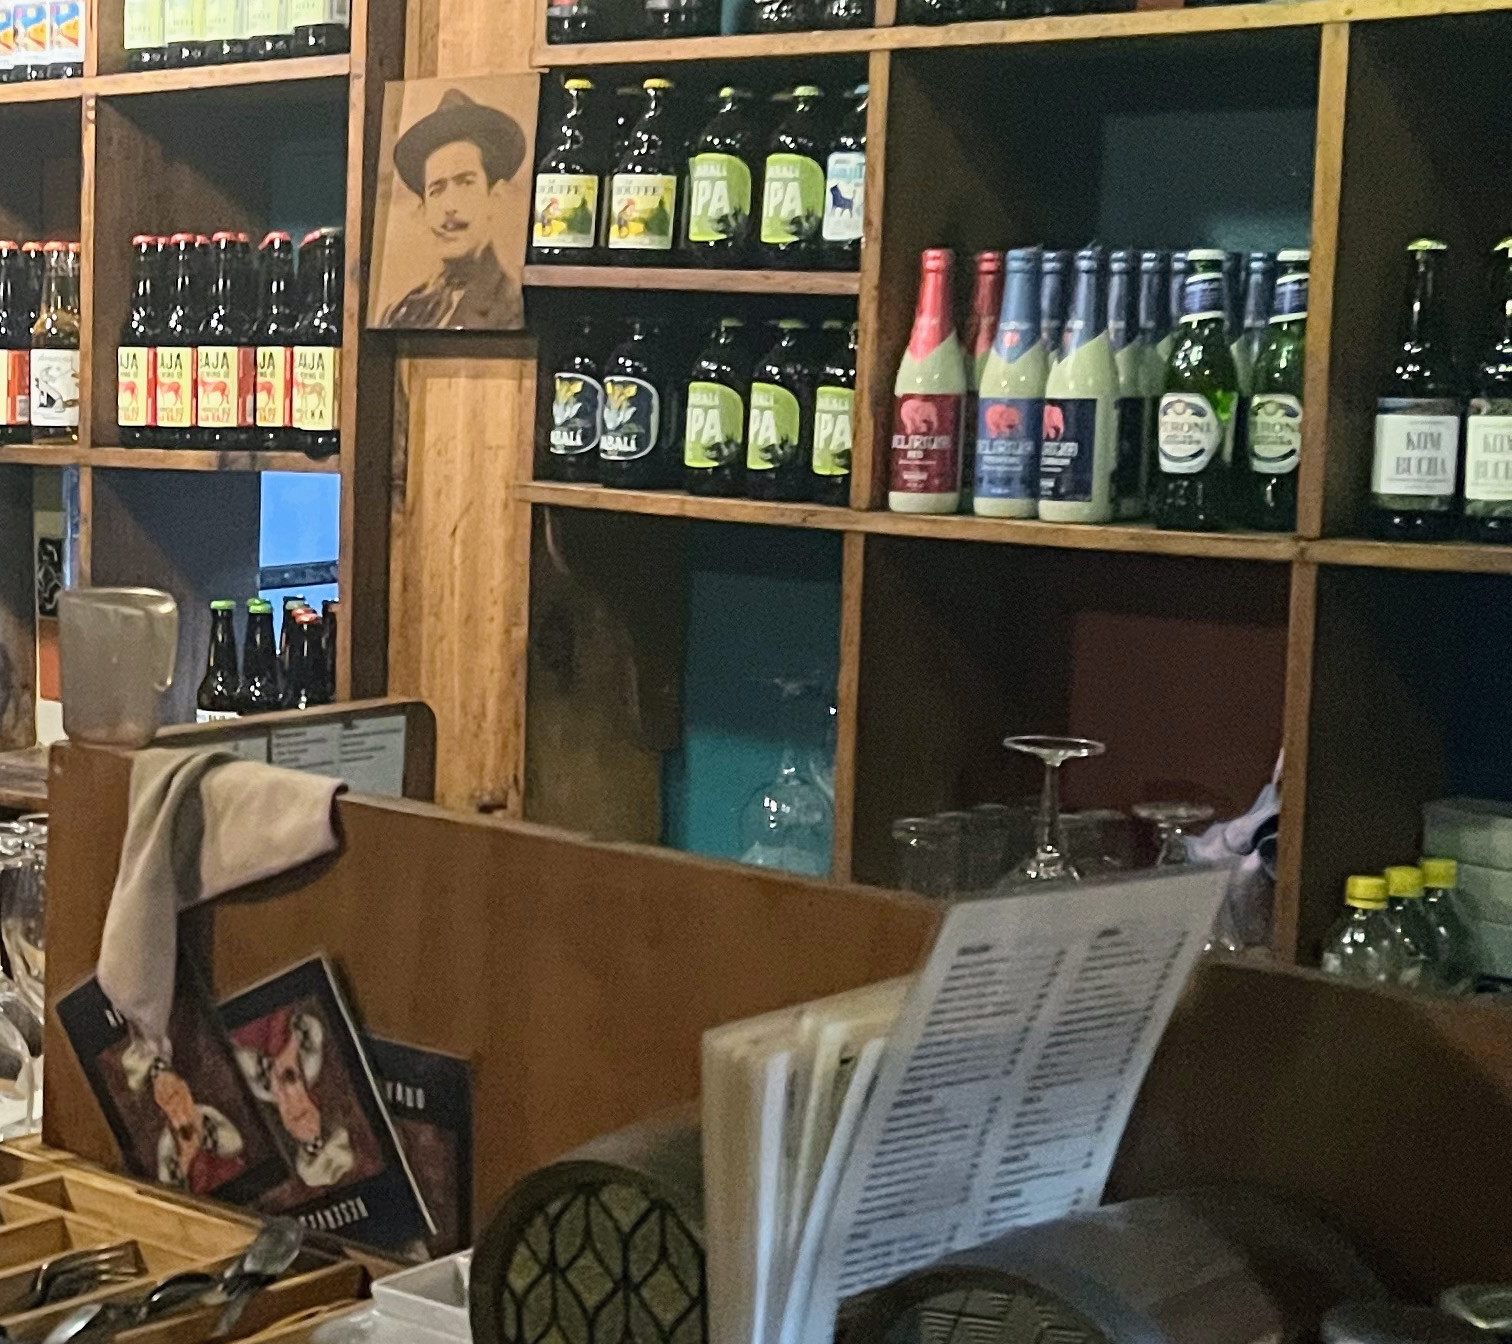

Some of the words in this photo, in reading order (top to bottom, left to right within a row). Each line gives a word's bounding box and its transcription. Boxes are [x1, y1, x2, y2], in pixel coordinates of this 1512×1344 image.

[691, 179, 730, 216] IPA
[161, 352, 183, 369] AJA
[748, 409, 778, 442] PA
[977, 438, 1034, 455] ELIRIUM
[1405, 431, 1442, 451] KOM
[1395, 456, 1447, 476] BUCHA
